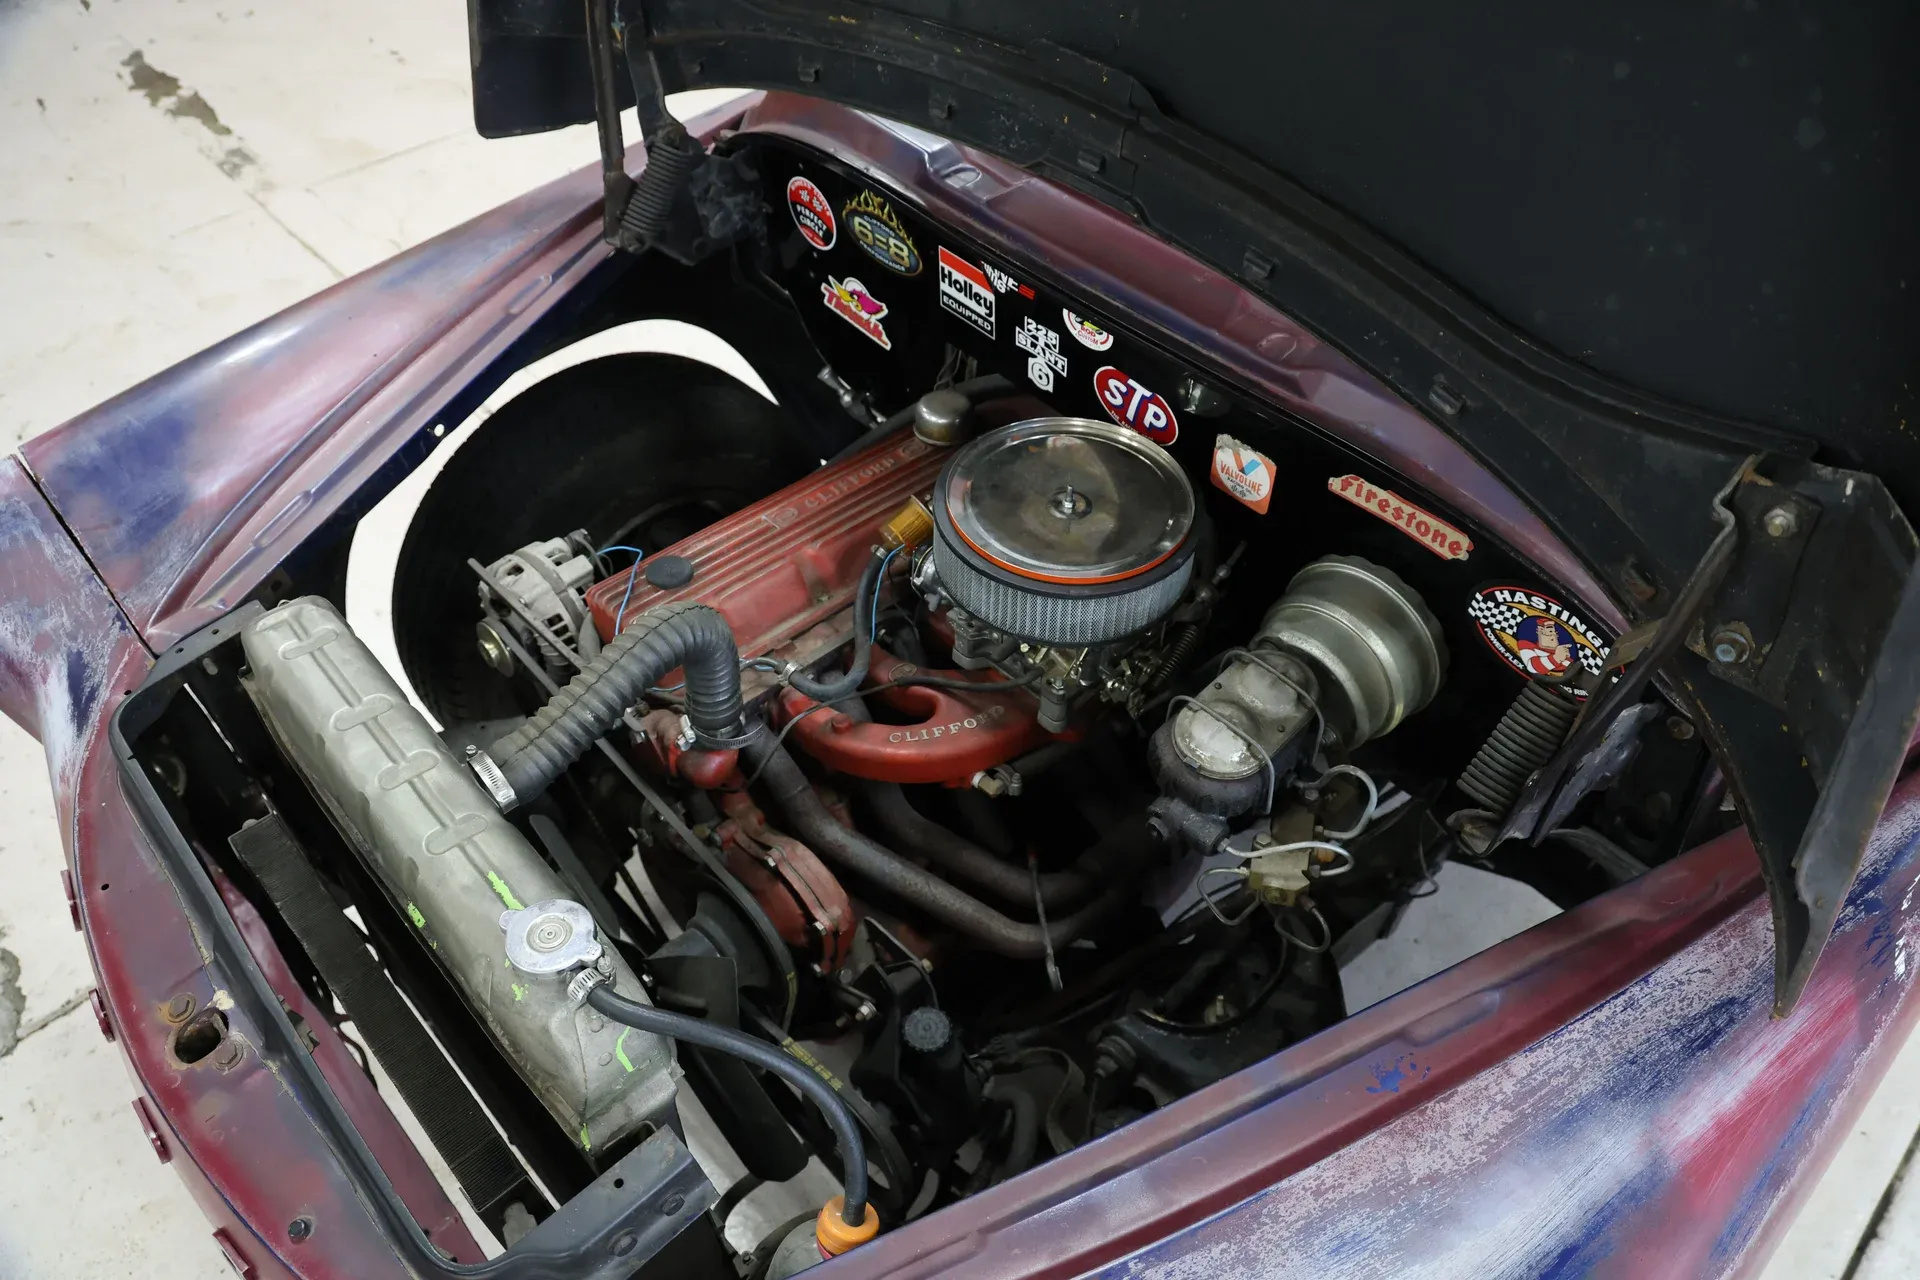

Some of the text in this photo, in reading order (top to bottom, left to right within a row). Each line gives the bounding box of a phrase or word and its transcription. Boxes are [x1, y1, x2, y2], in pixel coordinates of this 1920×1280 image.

[796, 204, 827, 231] PERFECT
[800, 215, 823, 238] CIRCLE
[863, 215, 895, 237] CLIFFORD
[853, 216, 910, 268] 6=8
[859, 240, 906, 271] PERFORMANCE
[941, 266, 993, 319] Holley
[943, 295, 991, 331] EQUIPPED
[1027, 318, 1057, 345] 225
[1018, 333, 1065, 370] SLANT
[1031, 361, 1050, 387] 6
[1104, 378, 1168, 429] STP
[1220, 460, 1263, 497] VALVOLINE
[1340, 476, 1463, 556] Firestone
[1484, 627, 1525, 670] POWER-FLEX
